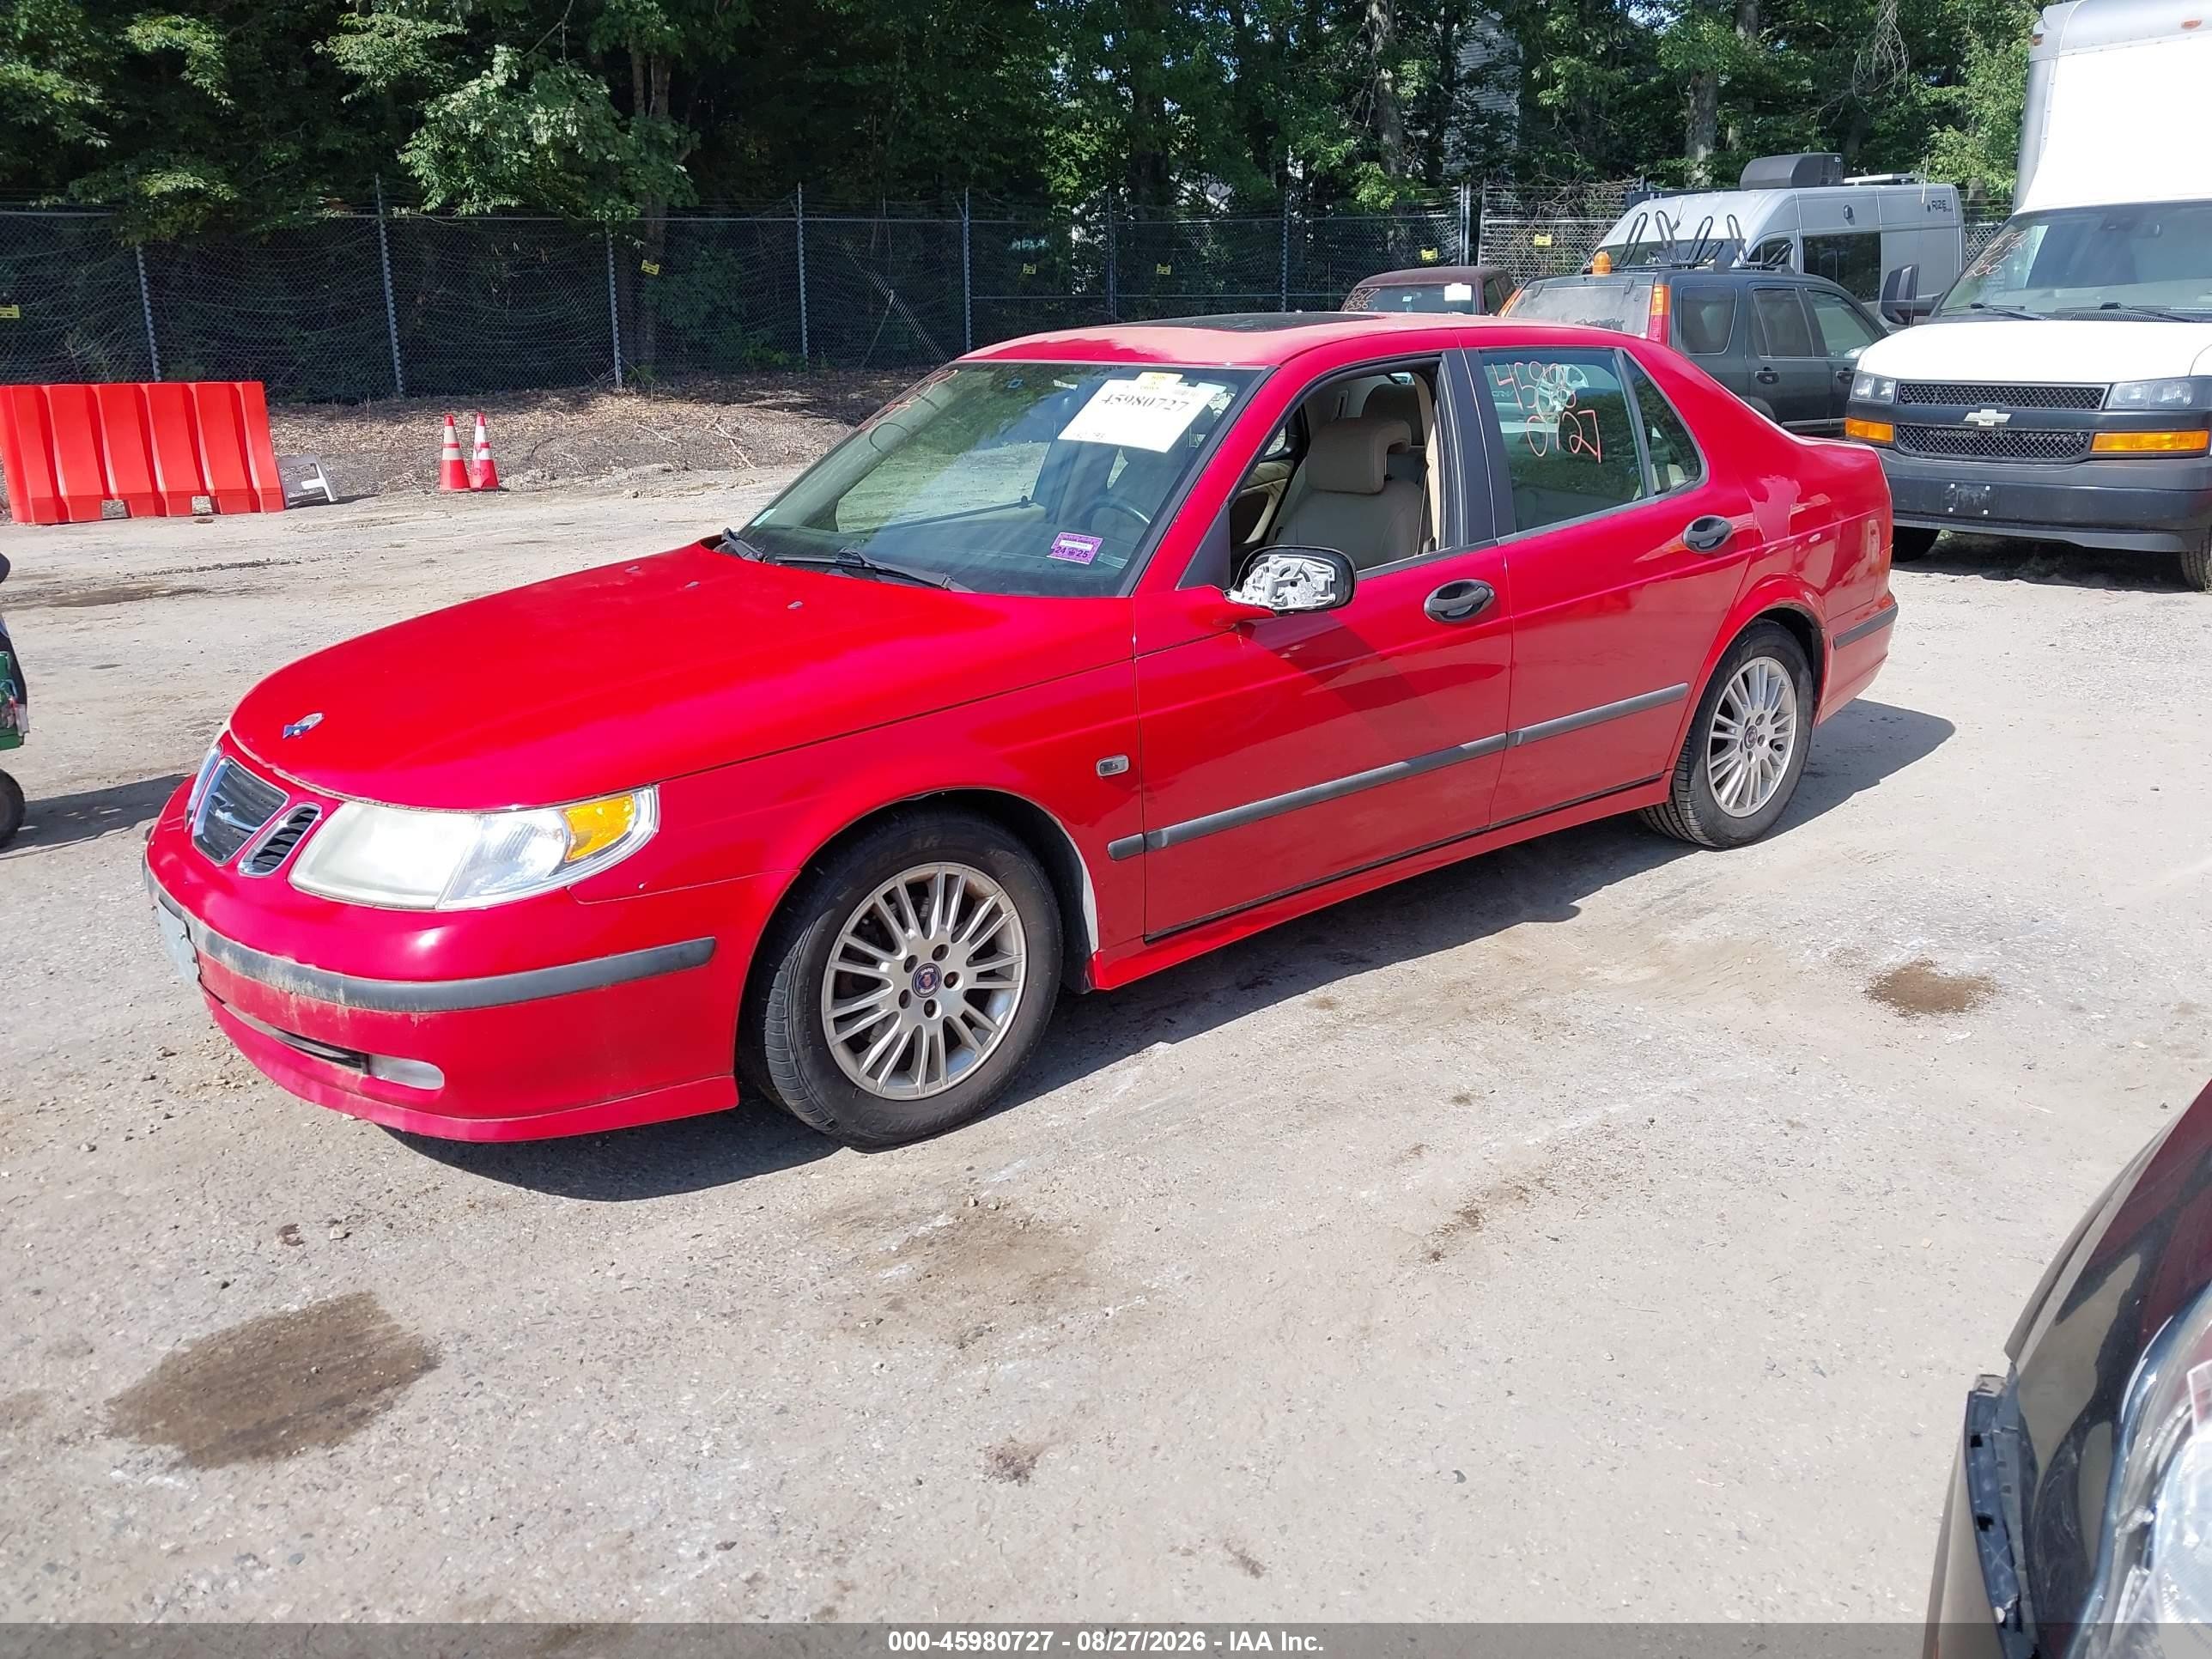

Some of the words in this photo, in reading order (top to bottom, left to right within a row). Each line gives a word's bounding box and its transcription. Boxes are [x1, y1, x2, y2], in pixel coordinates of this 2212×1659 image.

[1099, 393, 1189, 411] 45980727
[1055, 545, 1066, 554] 24
[1076, 550, 1089, 558] 25
